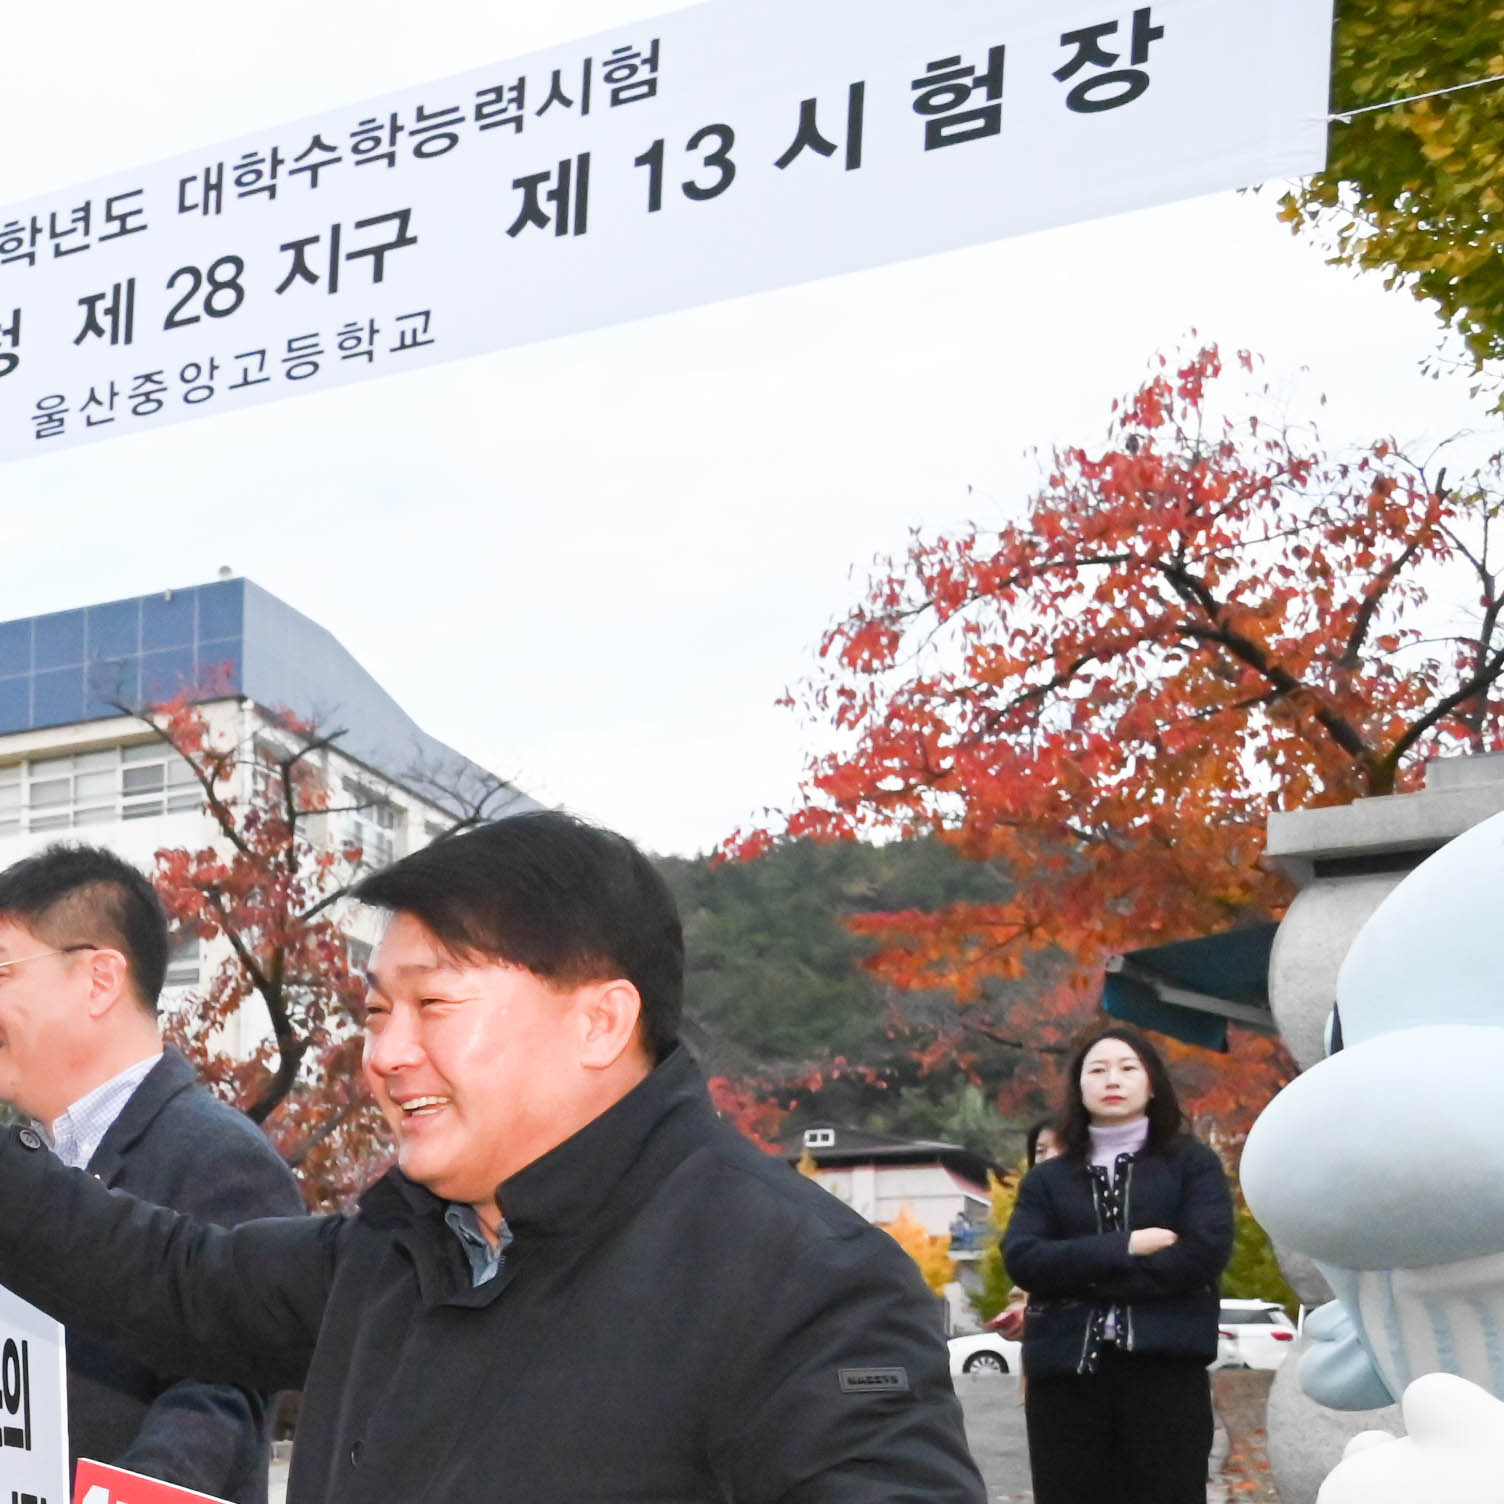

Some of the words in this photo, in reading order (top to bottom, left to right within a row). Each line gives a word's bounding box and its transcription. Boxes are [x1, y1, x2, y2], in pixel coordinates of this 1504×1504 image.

[179, 39, 659, 215] 대학수학능력시험
[74, 278, 135, 345] 제
[164, 256, 244, 330] 28
[276, 208, 417, 294] 지구
[507, 152, 590, 237] 제
[635, 124, 735, 212] 13
[32, 311, 434, 439] 울산중앙고등학교
